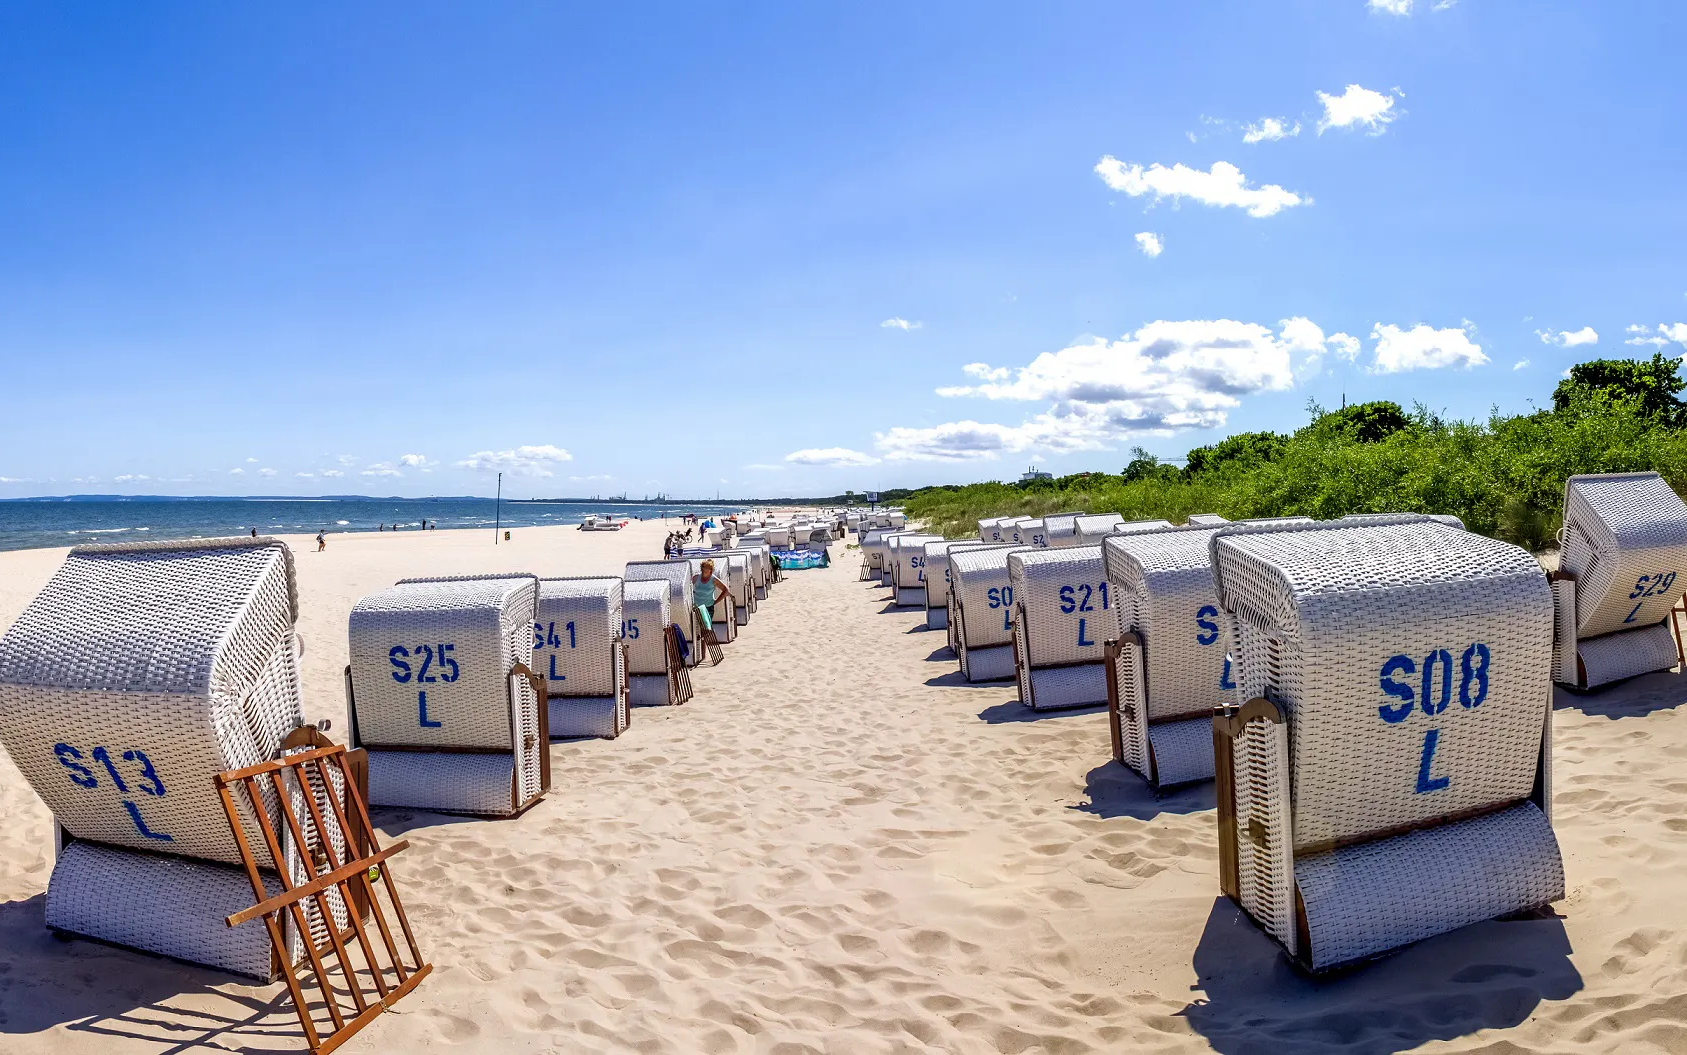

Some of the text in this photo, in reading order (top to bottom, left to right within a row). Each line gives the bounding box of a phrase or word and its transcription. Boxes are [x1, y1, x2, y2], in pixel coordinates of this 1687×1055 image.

[1059, 581, 1109, 614] S21
[1629, 571, 1677, 599] S29
[1622, 602, 1643, 623] L
[1077, 618, 1095, 646] L
[388, 643, 460, 684] S25
[549, 654, 566, 680] L
[1219, 653, 1237, 690] L
[1378, 643, 1491, 724] S08
[418, 691, 441, 728] L
[53, 742, 167, 797] S13
[1415, 728, 1450, 794] L
[123, 800, 174, 842] L
